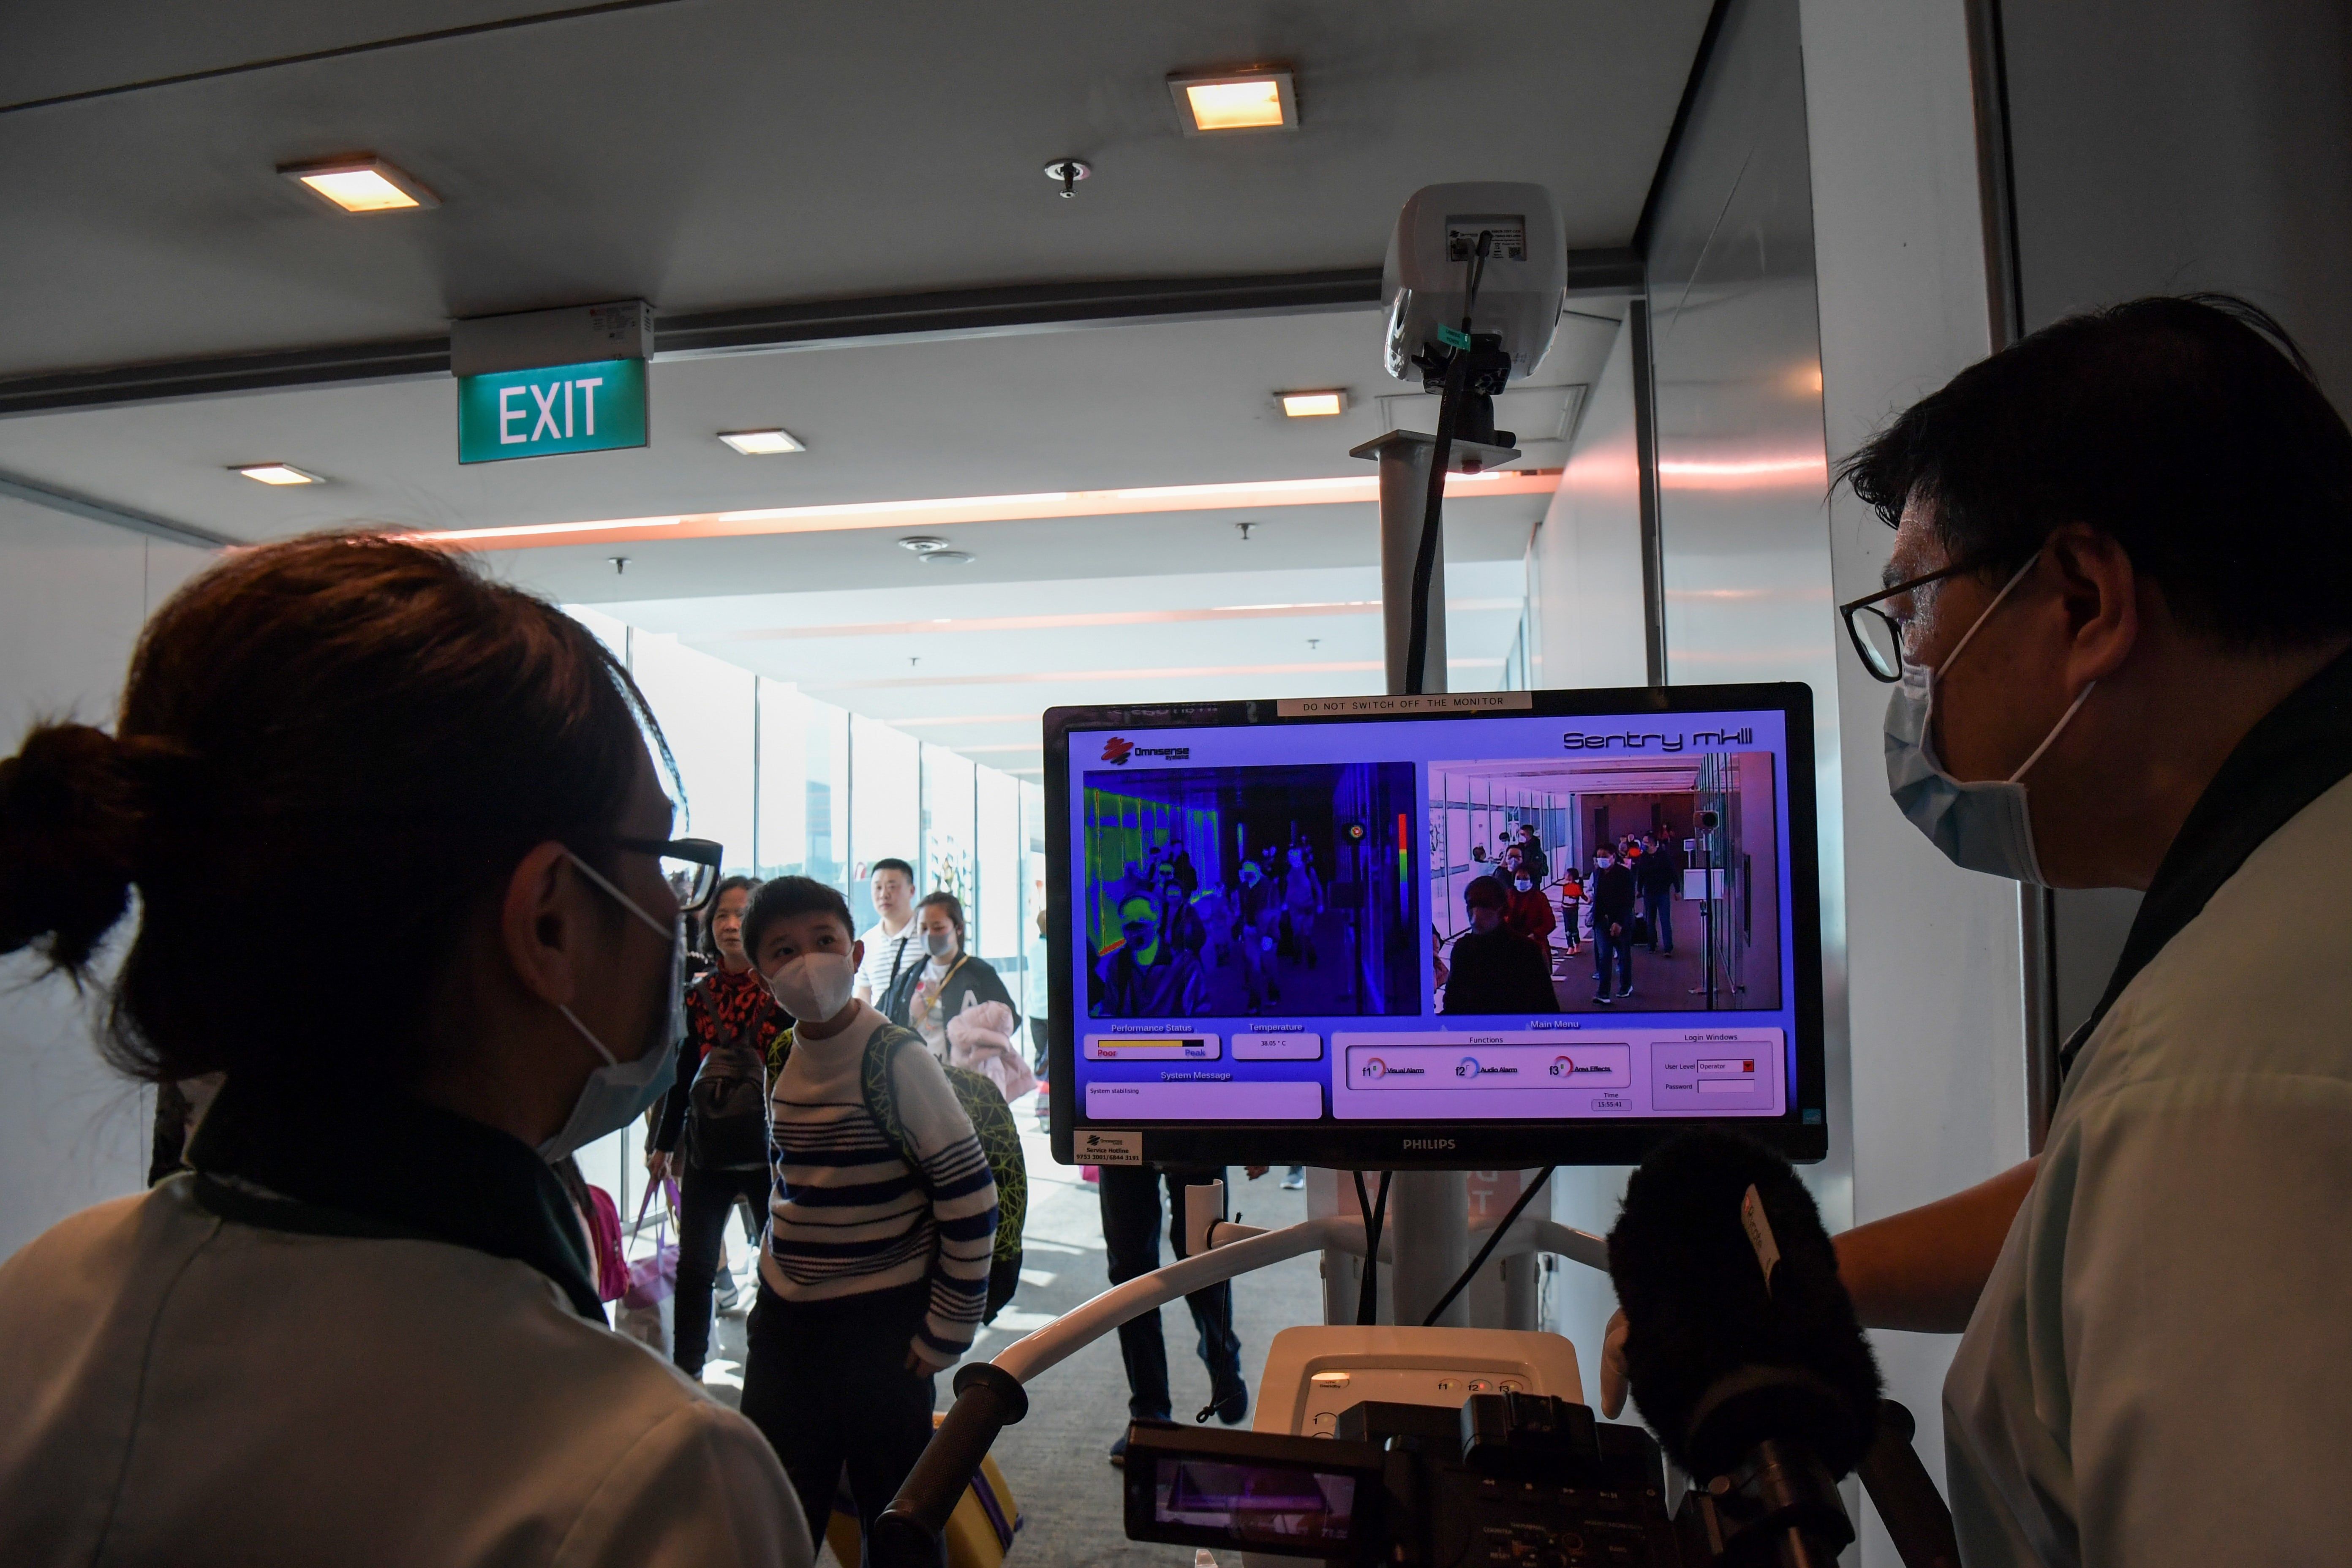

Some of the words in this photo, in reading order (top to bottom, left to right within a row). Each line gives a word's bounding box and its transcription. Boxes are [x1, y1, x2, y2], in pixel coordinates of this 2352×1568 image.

[499, 378, 603, 444] EXIT
[1353, 701, 1394, 710] SWITCH
[1427, 699, 1446, 707] THE
[1454, 697, 1503, 706] MONITOR
[1564, 731, 1683, 752] Sentry
[1135, 747, 1189, 756] Omnisense
[1249, 1024, 1303, 1032] Temperature
[1362, 1067, 1371, 1076] f1
[1455, 1067, 1465, 1075] f2
[1549, 1066, 1559, 1075] f3
[1161, 1072, 1191, 1080] System
[1193, 1072, 1231, 1080] Message
[1403, 1139, 1456, 1149] PHILIPS
